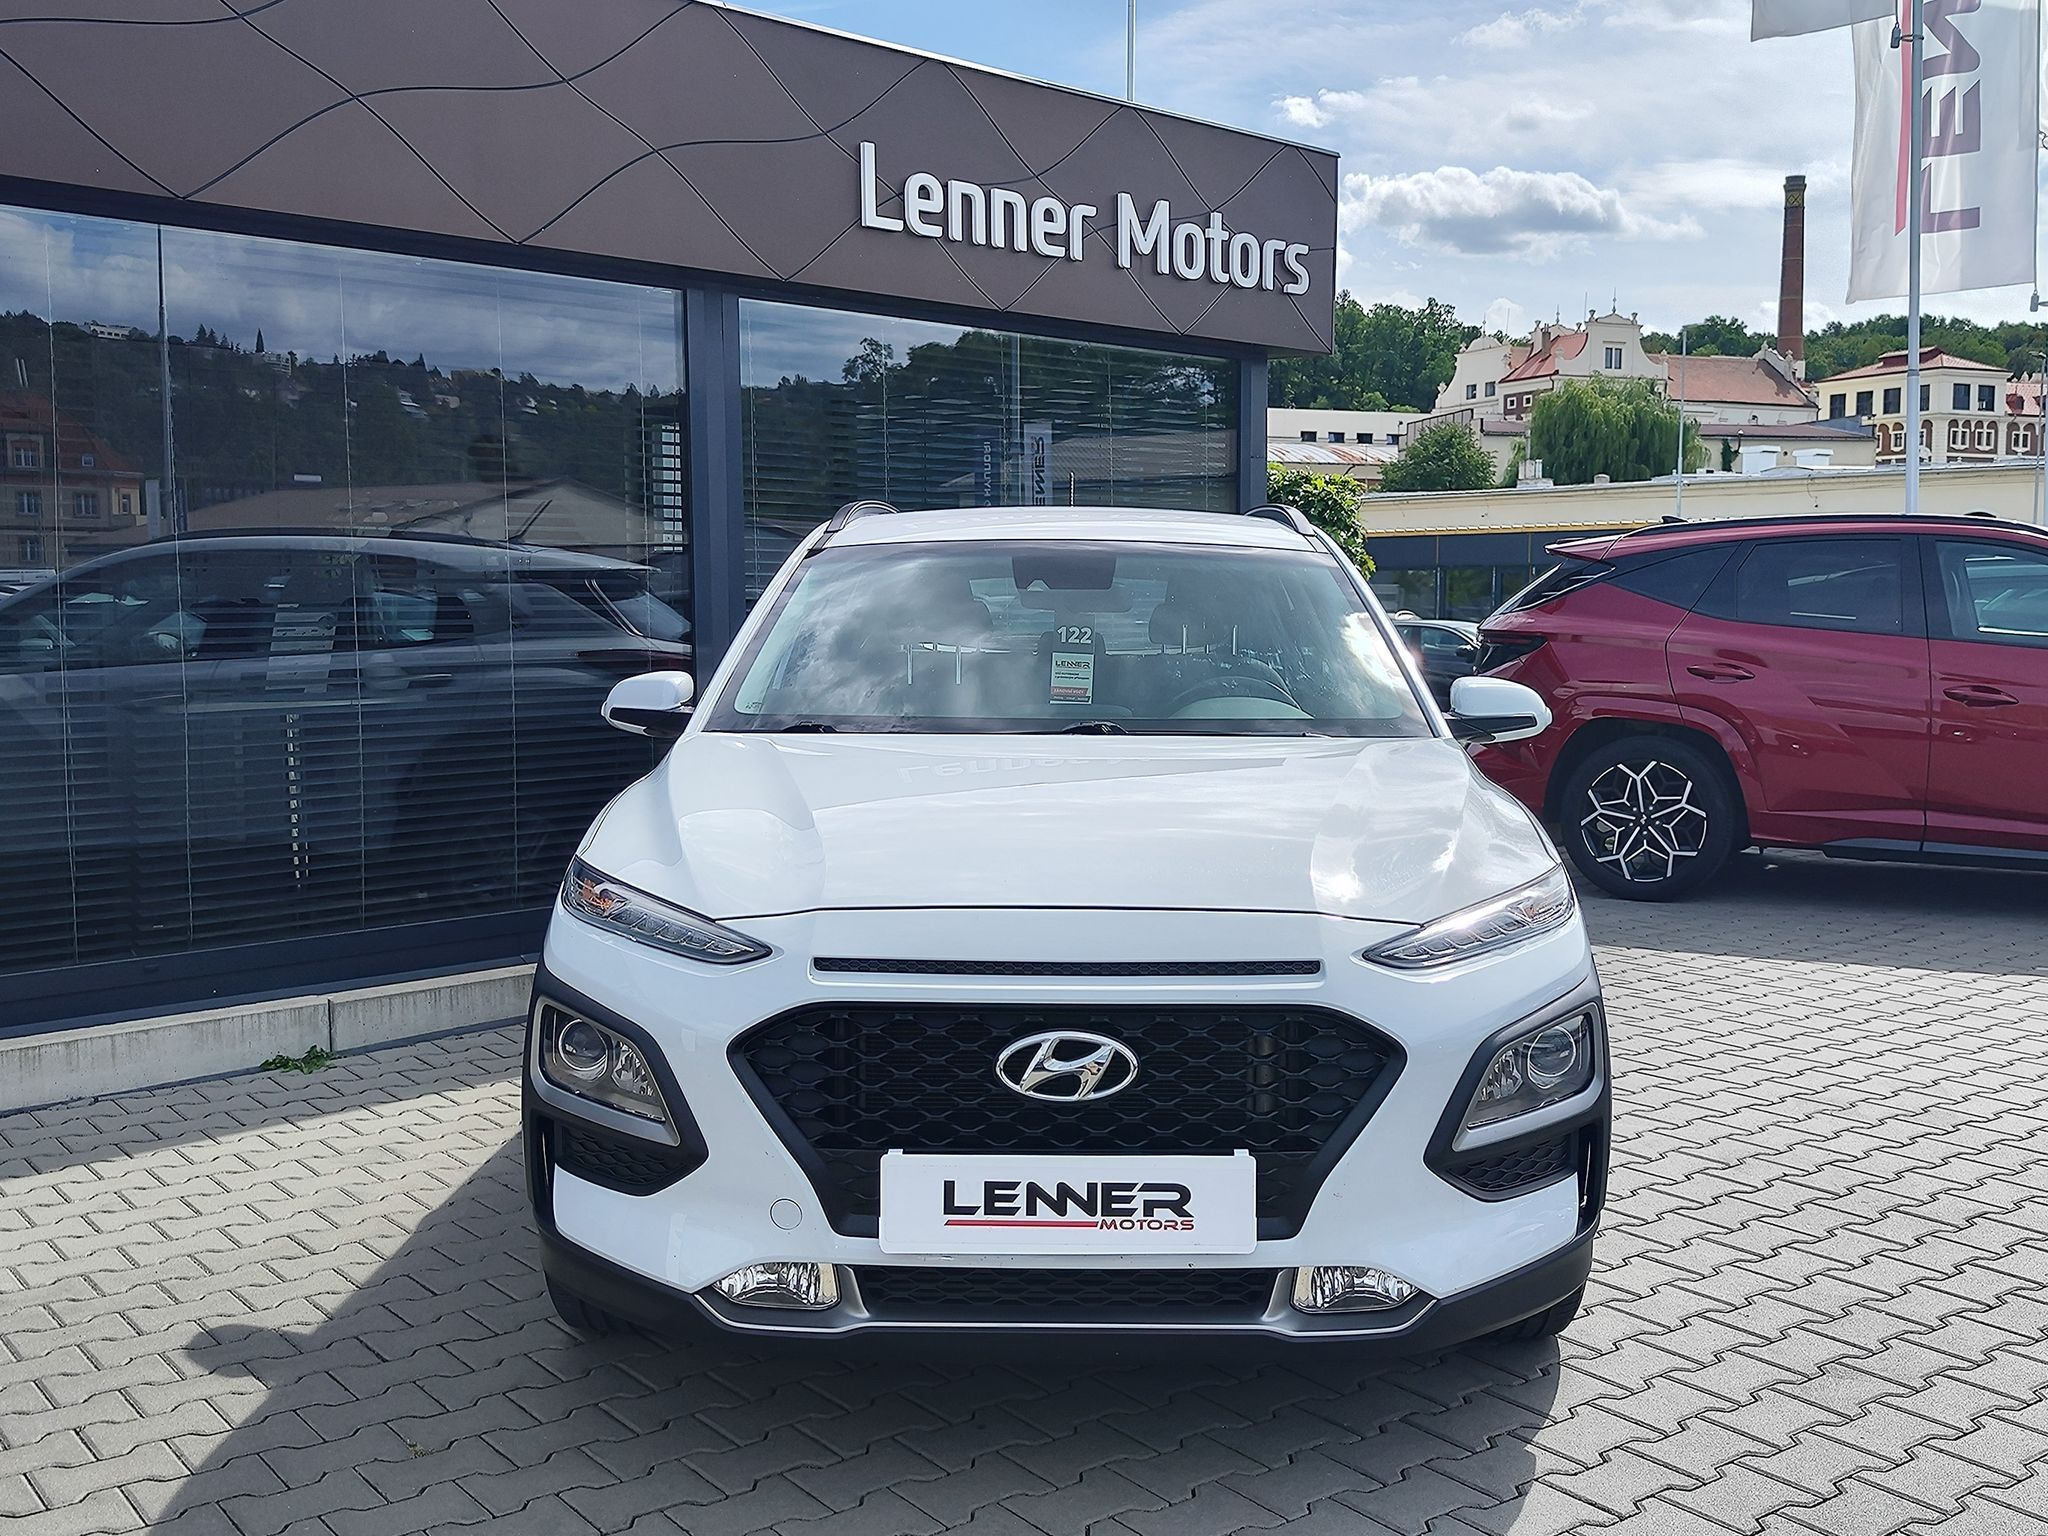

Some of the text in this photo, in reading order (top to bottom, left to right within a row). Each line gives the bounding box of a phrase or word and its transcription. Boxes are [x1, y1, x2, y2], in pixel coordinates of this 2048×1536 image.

[858, 141, 1310, 296] Lenner Motors
[1057, 626, 1093, 644] 122
[1055, 660, 1091, 669] LENNER
[943, 1180, 1195, 1217] LENNER
[1099, 1218, 1195, 1231] MOTORS
